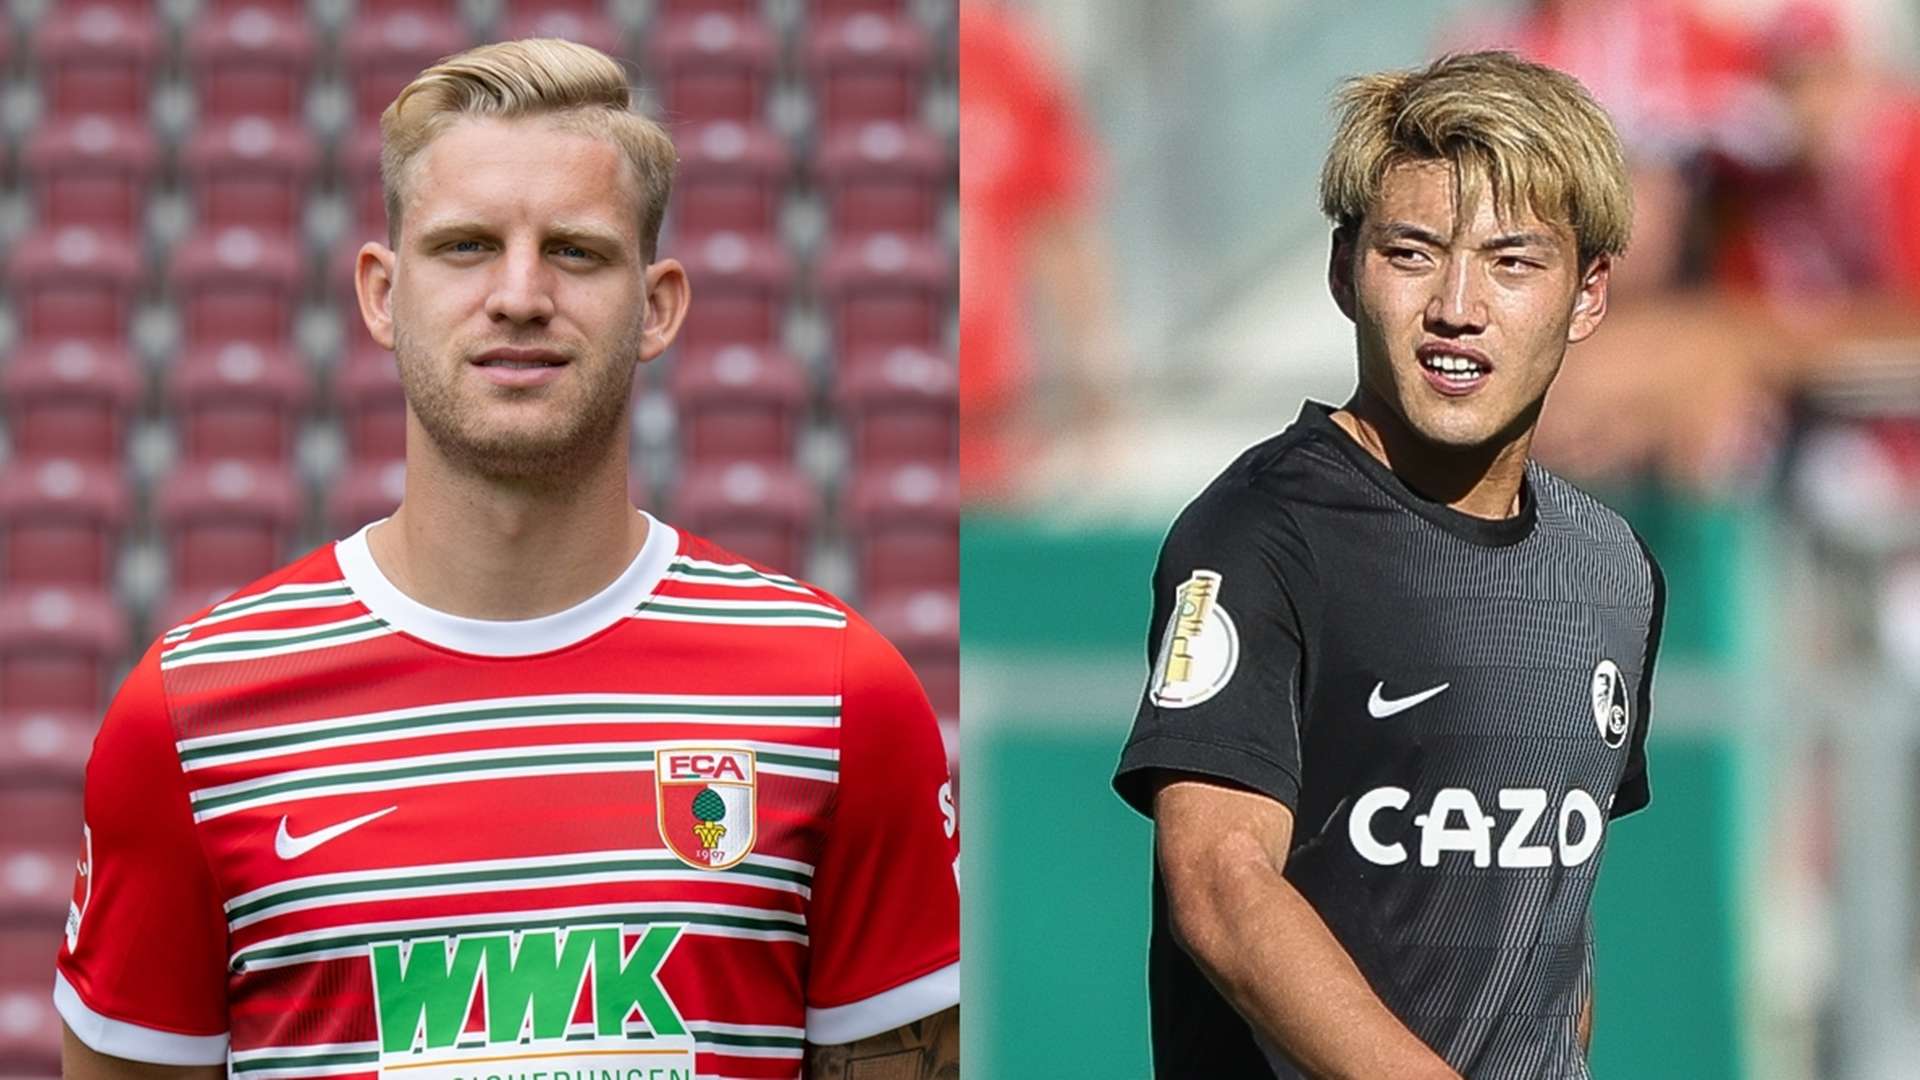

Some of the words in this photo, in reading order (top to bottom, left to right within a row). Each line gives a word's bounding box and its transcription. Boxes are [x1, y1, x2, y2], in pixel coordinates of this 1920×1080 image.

[669, 755, 746, 780] FCA
[1348, 786, 1615, 868] CAZO
[372, 925, 686, 1054] WWK
